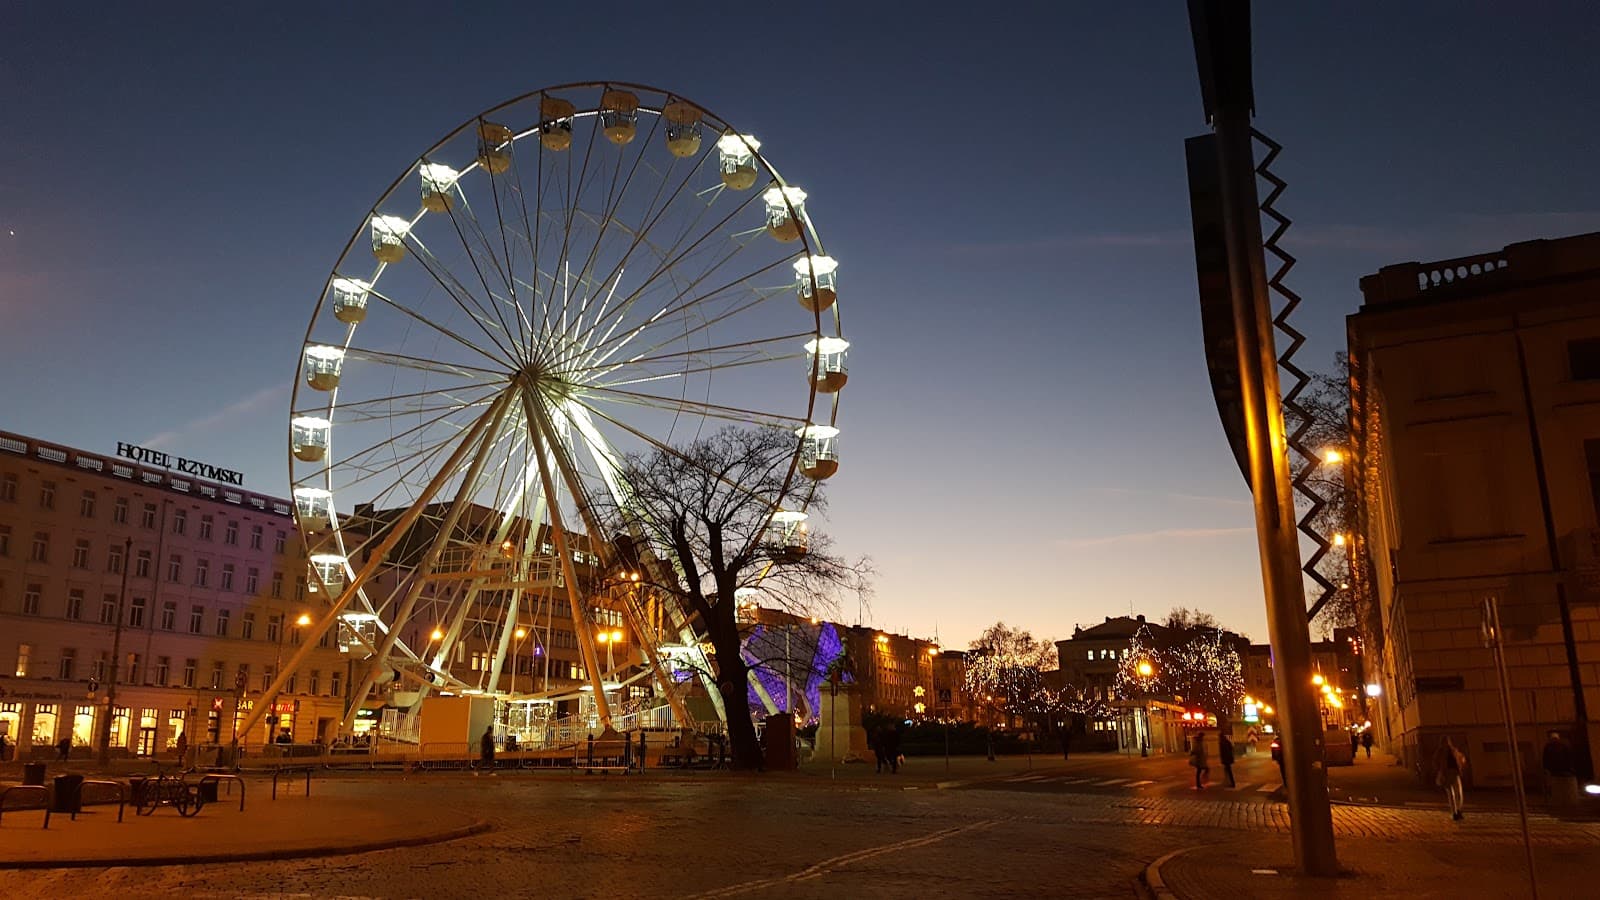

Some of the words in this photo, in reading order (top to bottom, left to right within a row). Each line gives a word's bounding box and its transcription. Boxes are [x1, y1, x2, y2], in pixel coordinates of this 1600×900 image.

[116, 442, 171, 468] HOTEL
[177, 457, 243, 485] RZYMSKI
[236, 700, 253, 710] BAR
